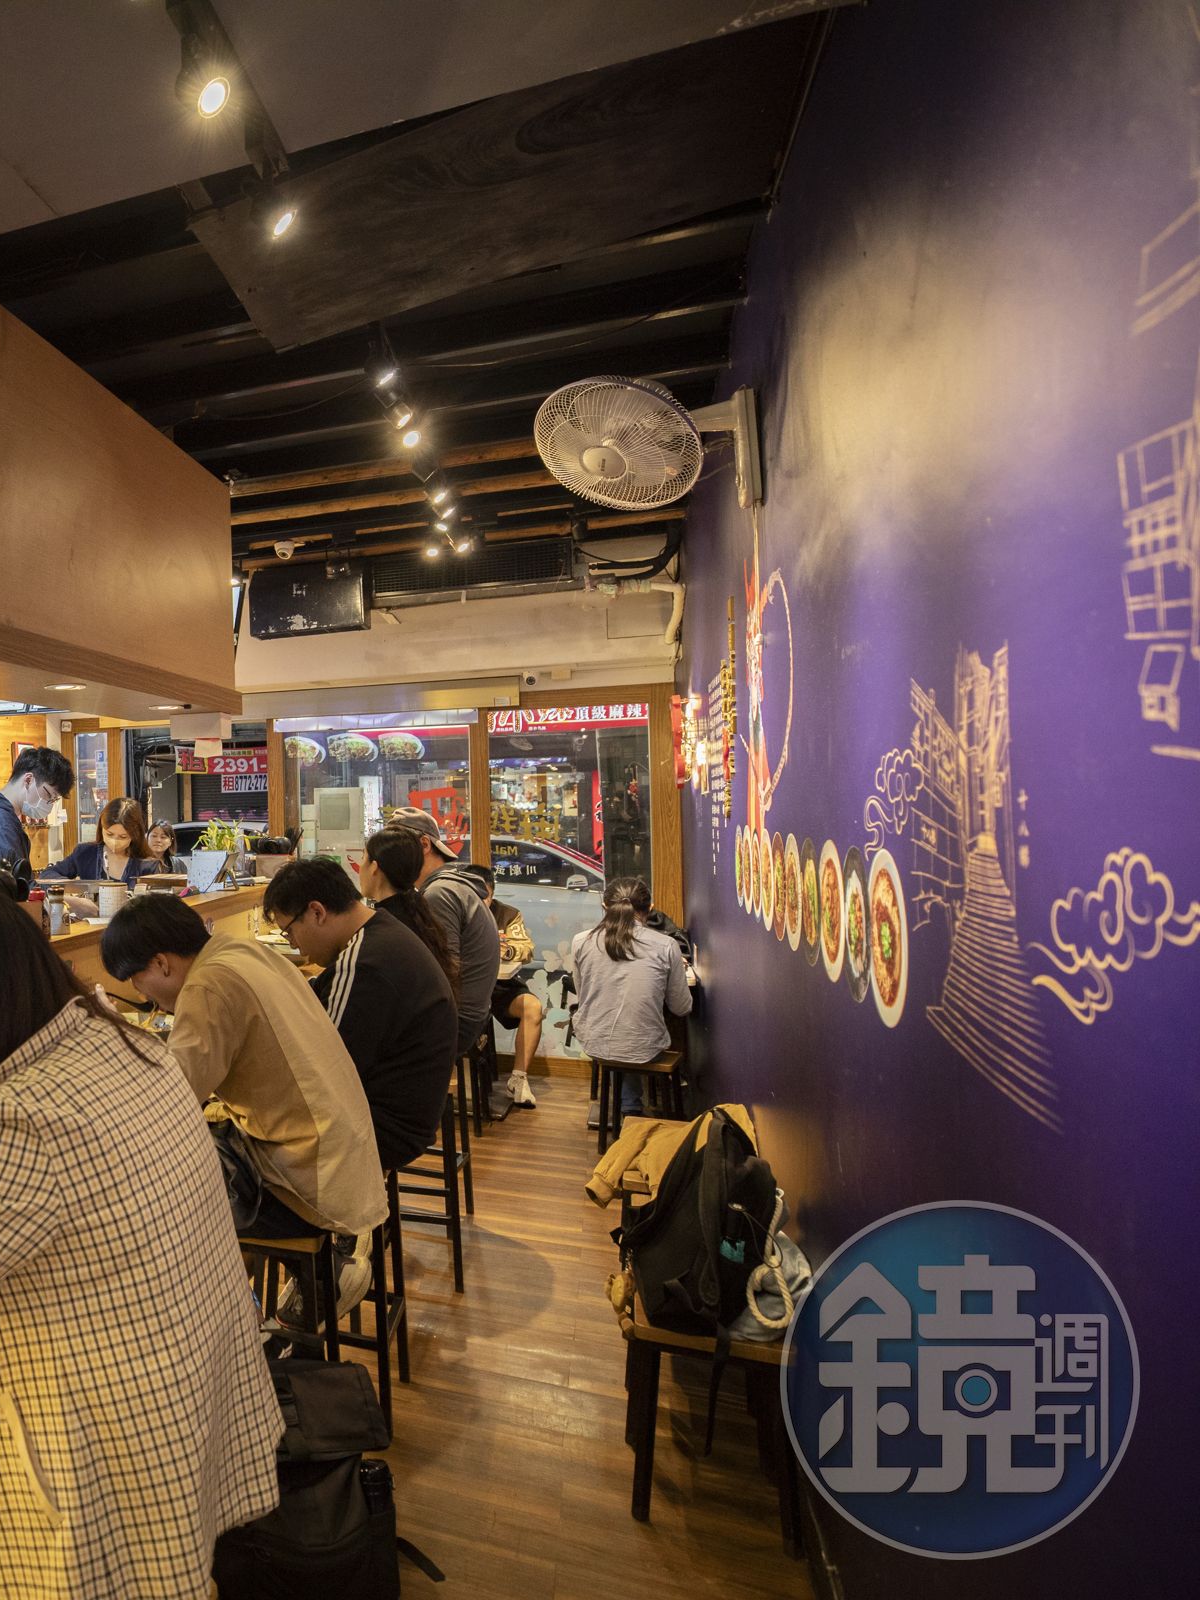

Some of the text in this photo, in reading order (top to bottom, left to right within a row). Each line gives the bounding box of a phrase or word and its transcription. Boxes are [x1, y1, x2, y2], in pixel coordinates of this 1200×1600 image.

[575, 703, 648, 720] 頂級麻辣
[178, 747, 206, 772] 租
